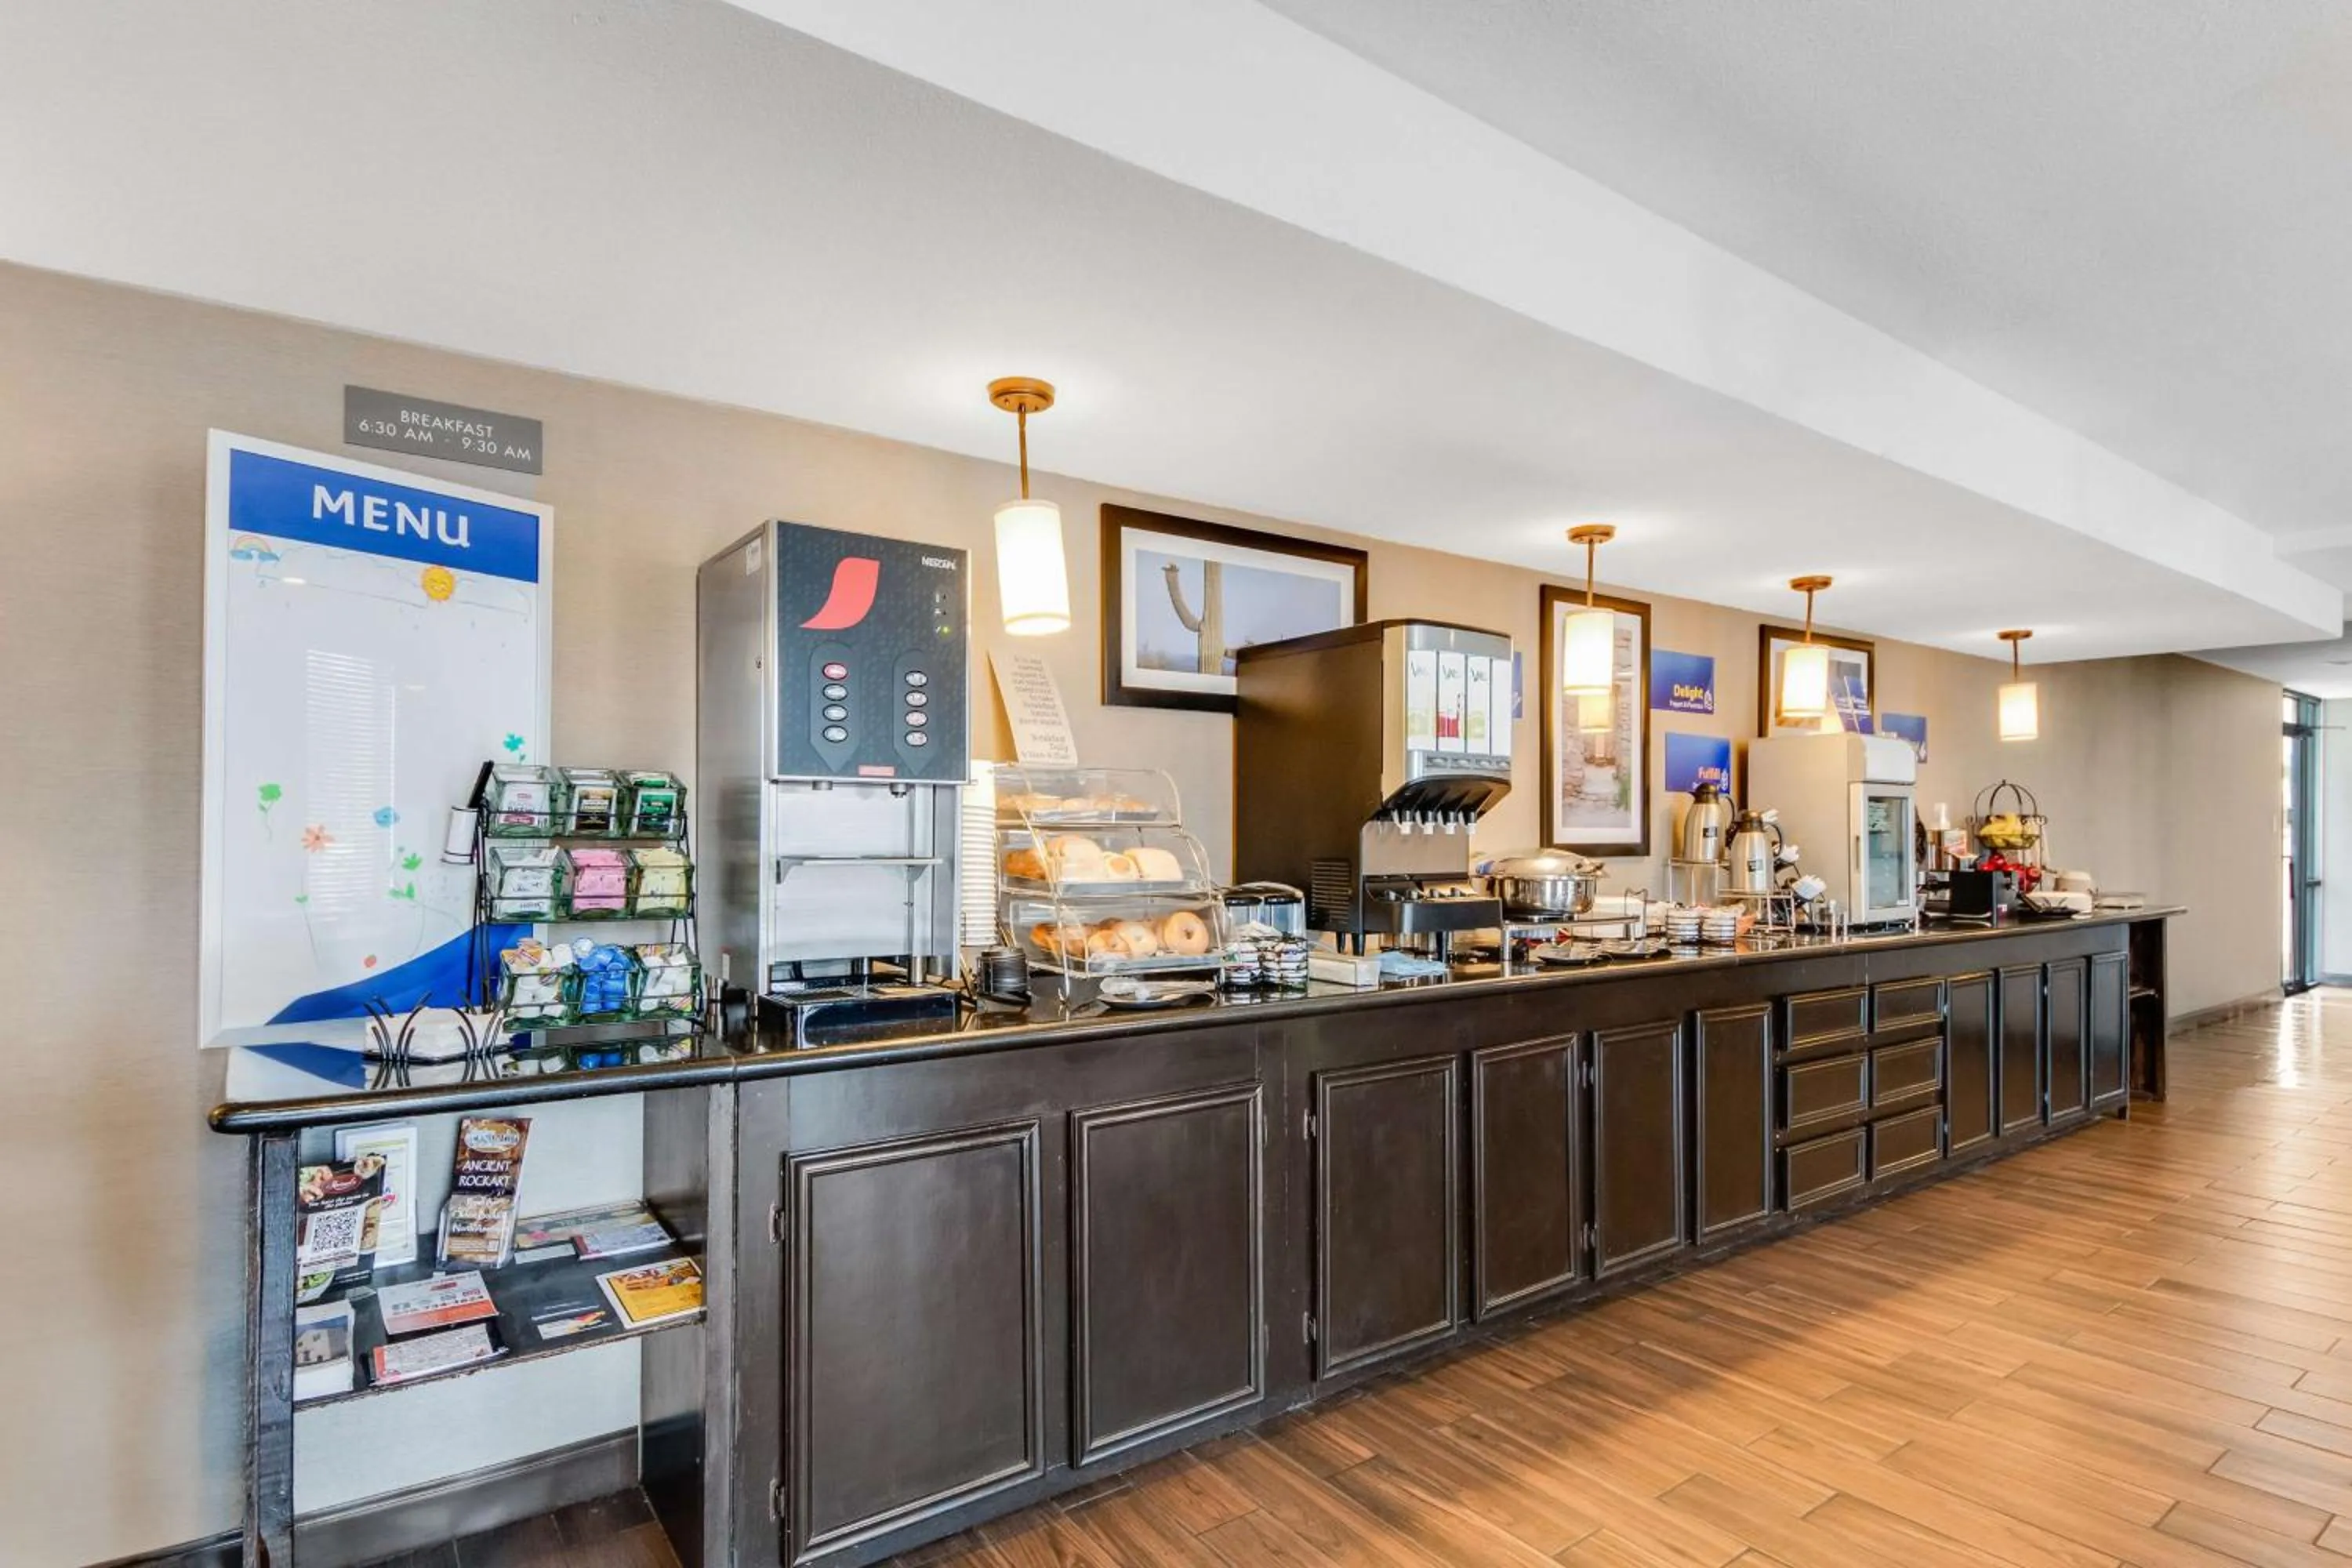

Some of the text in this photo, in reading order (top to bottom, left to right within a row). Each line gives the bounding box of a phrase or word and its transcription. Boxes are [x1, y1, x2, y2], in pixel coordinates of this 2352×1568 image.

[358, 419, 397, 437] 6:30
[404, 428, 434, 443] AM
[461, 437, 497, 455] 9:30
[504, 445, 531, 461] AM
[400, 409, 494, 438] BREAKFAST
[313, 484, 470, 549] MENU
[462, 1160, 511, 1173] ANCIENT
